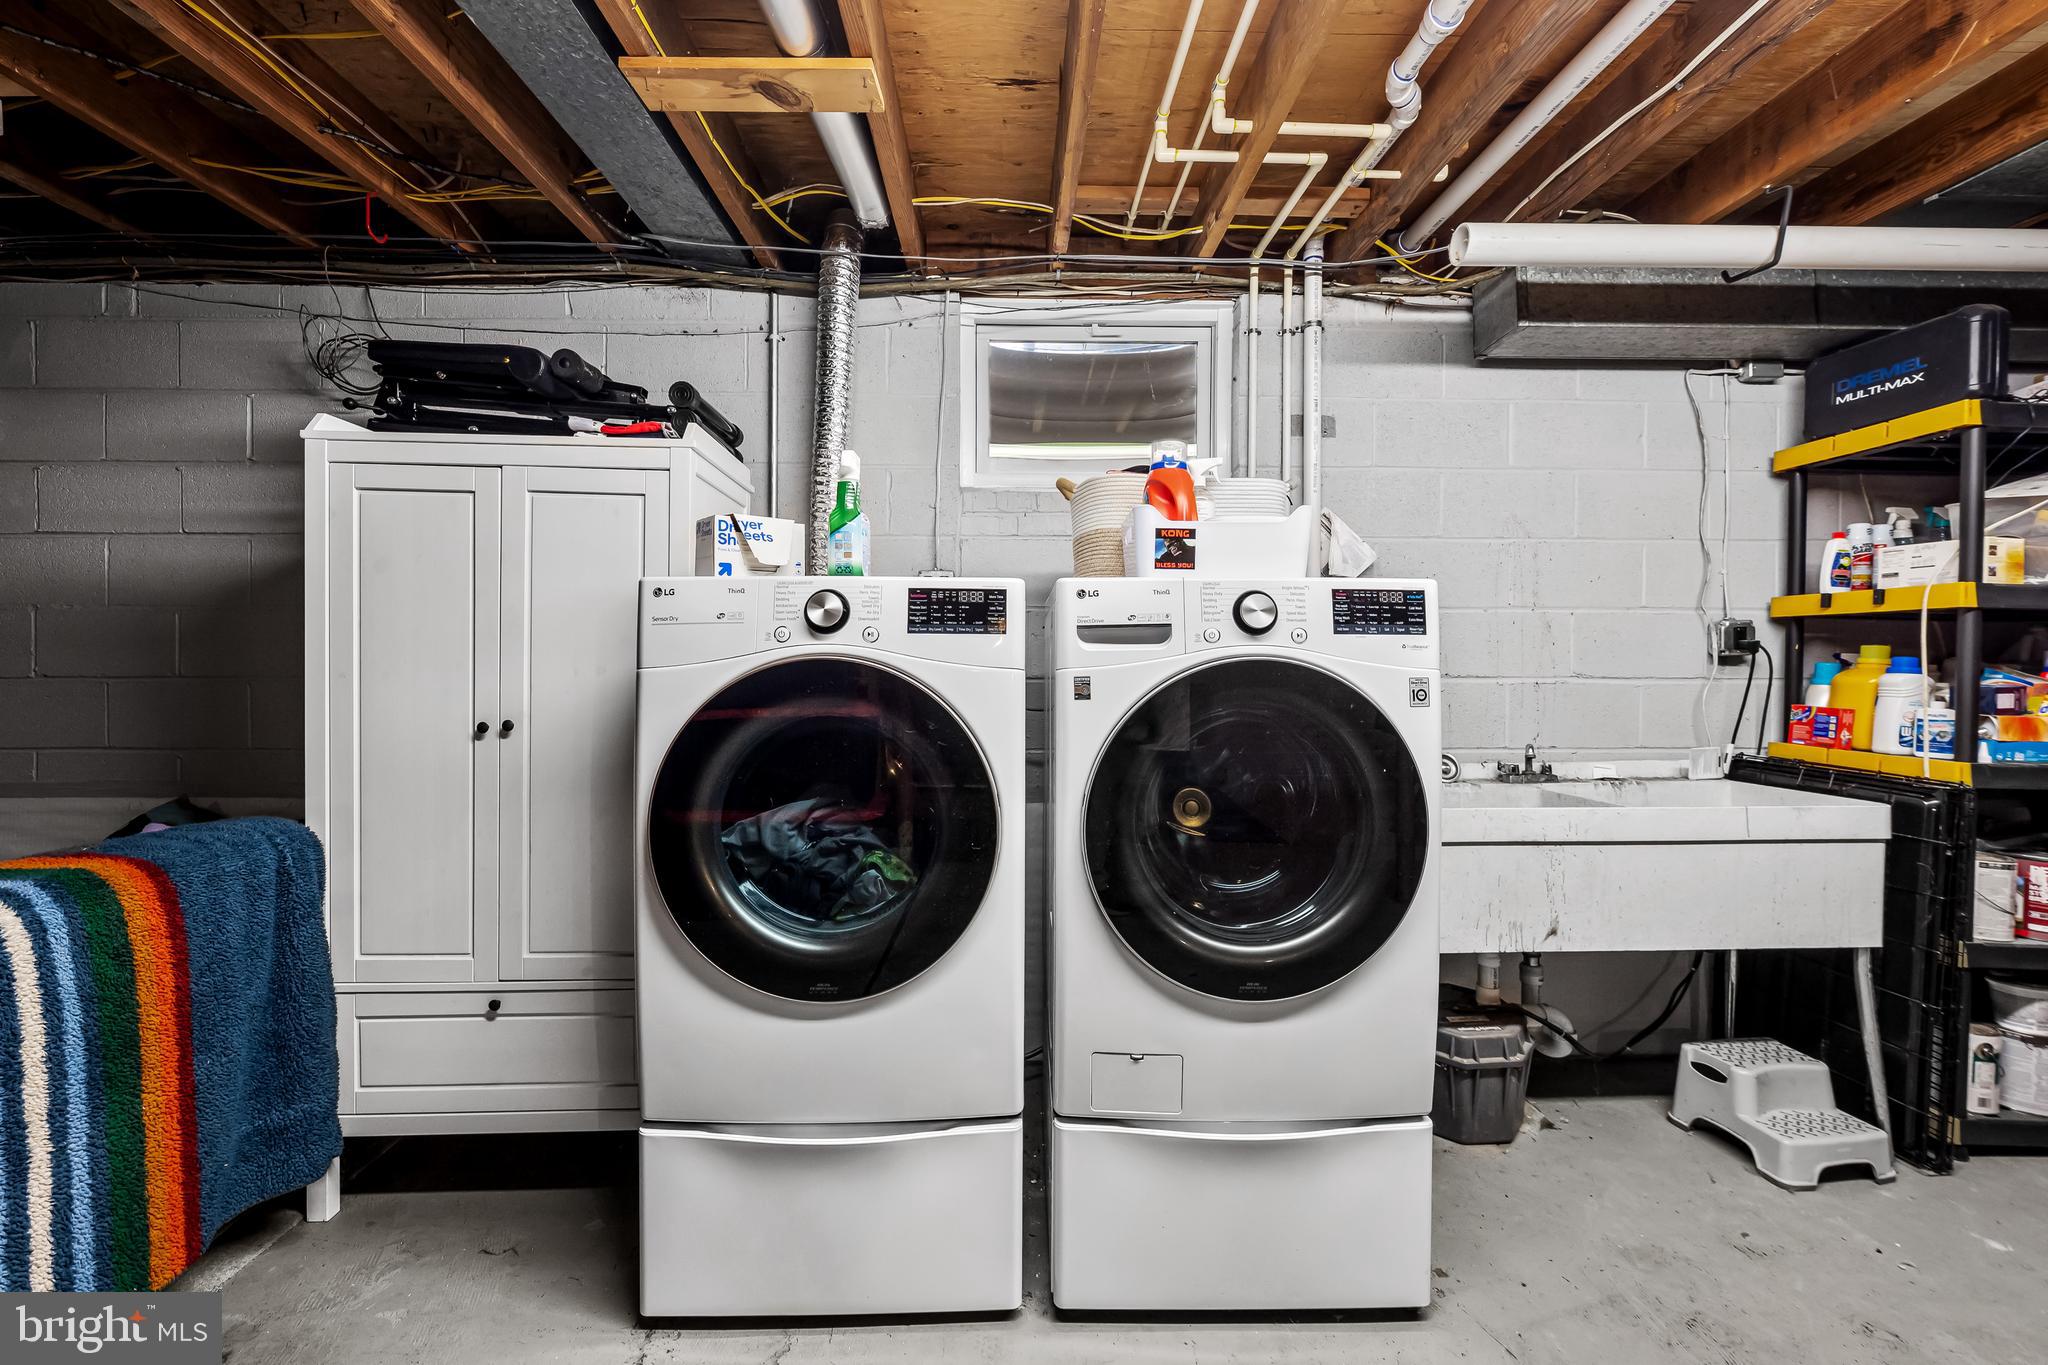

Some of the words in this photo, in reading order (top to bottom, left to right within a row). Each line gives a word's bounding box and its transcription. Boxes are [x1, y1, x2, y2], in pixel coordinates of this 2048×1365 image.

[1836, 356, 1928, 392] DREMEL
[1835, 372, 1925, 405] MULTI-MAX
[1161, 529, 1190, 538] KONG
[664, 588, 675, 596] LG
[1088, 589, 1099, 597] LG
[1412, 689, 1427, 702] 10
